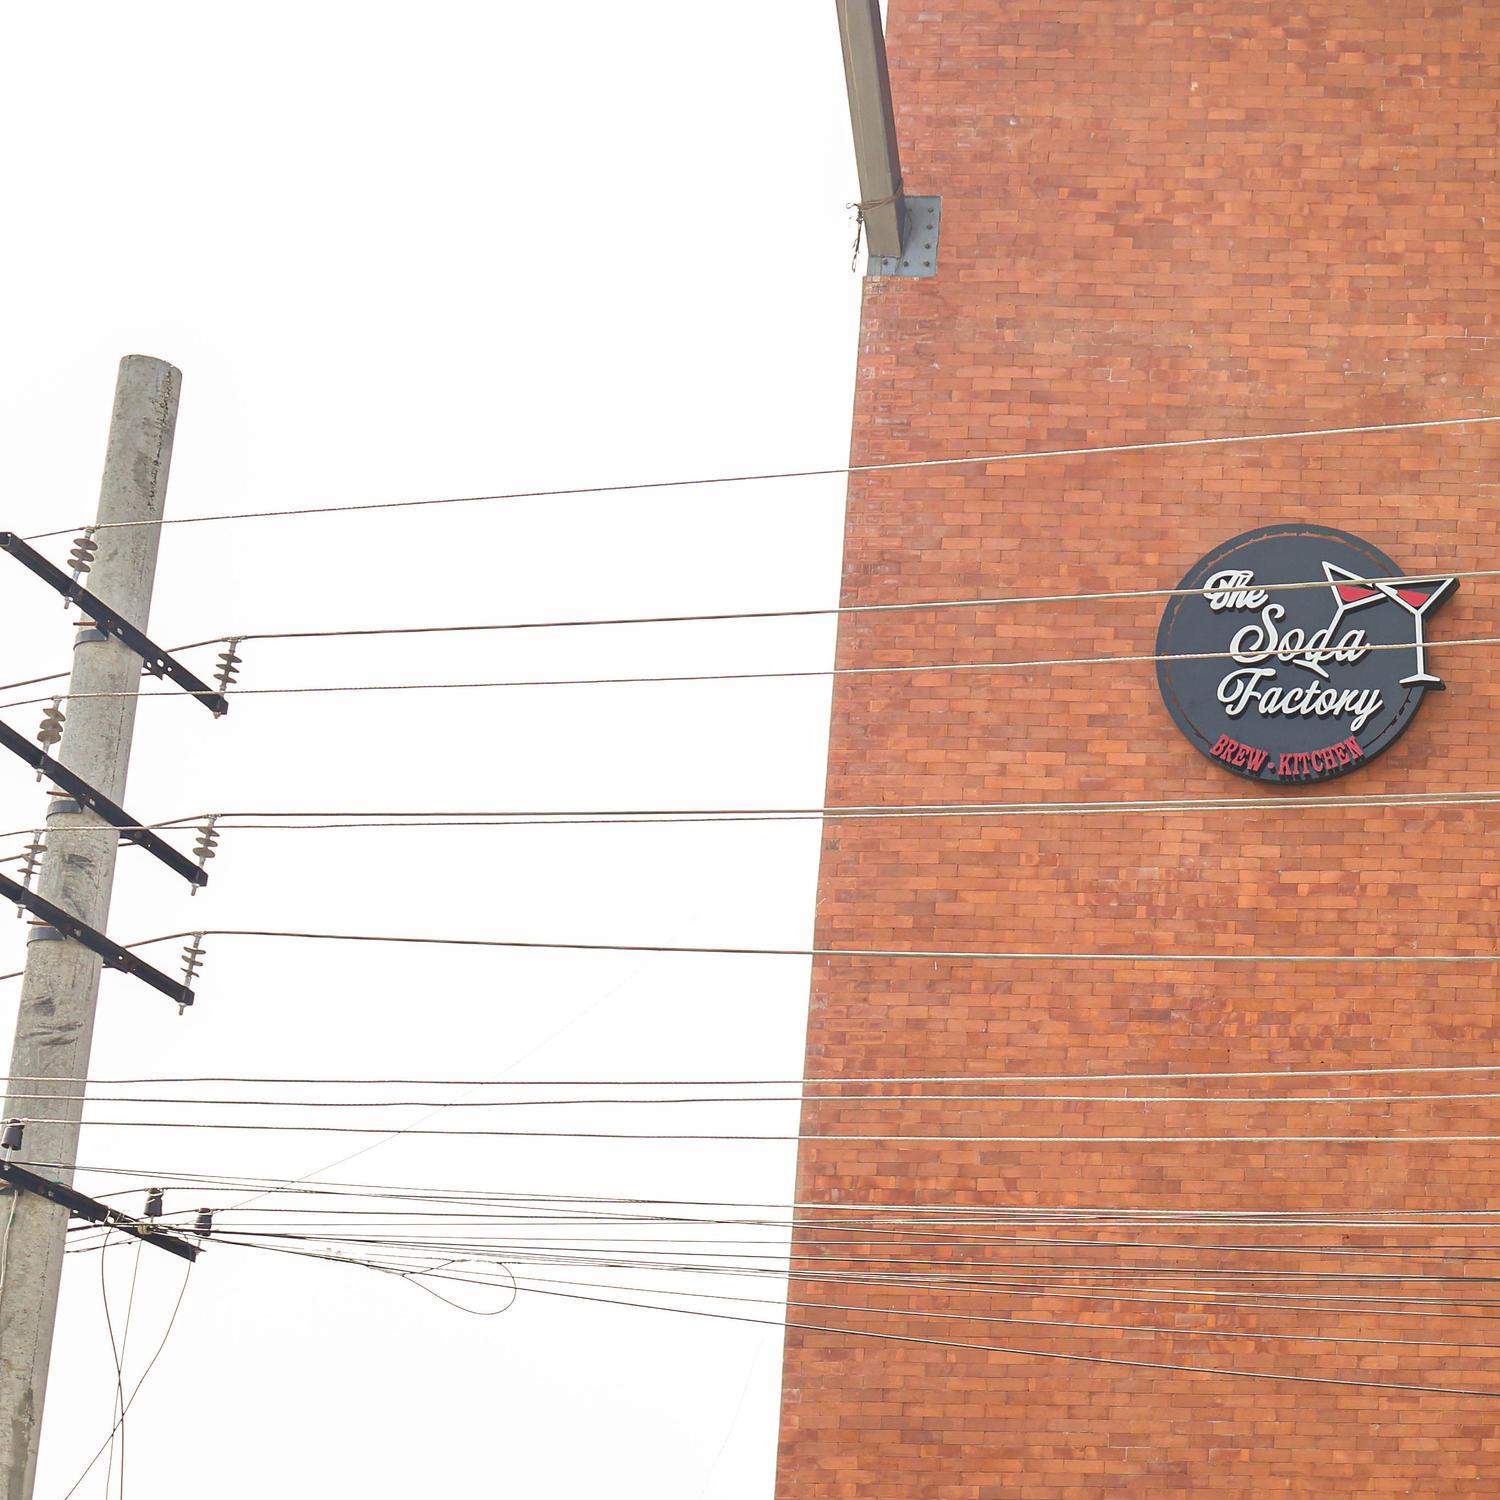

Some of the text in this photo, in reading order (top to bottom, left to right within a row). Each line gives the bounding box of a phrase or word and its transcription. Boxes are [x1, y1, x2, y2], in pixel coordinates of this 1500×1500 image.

[1202, 569, 1269, 611] The
[1229, 602, 1371, 665] Soda
[1216, 667, 1384, 732] Factory
[1210, 734, 1365, 777] BREW KITCHEN
